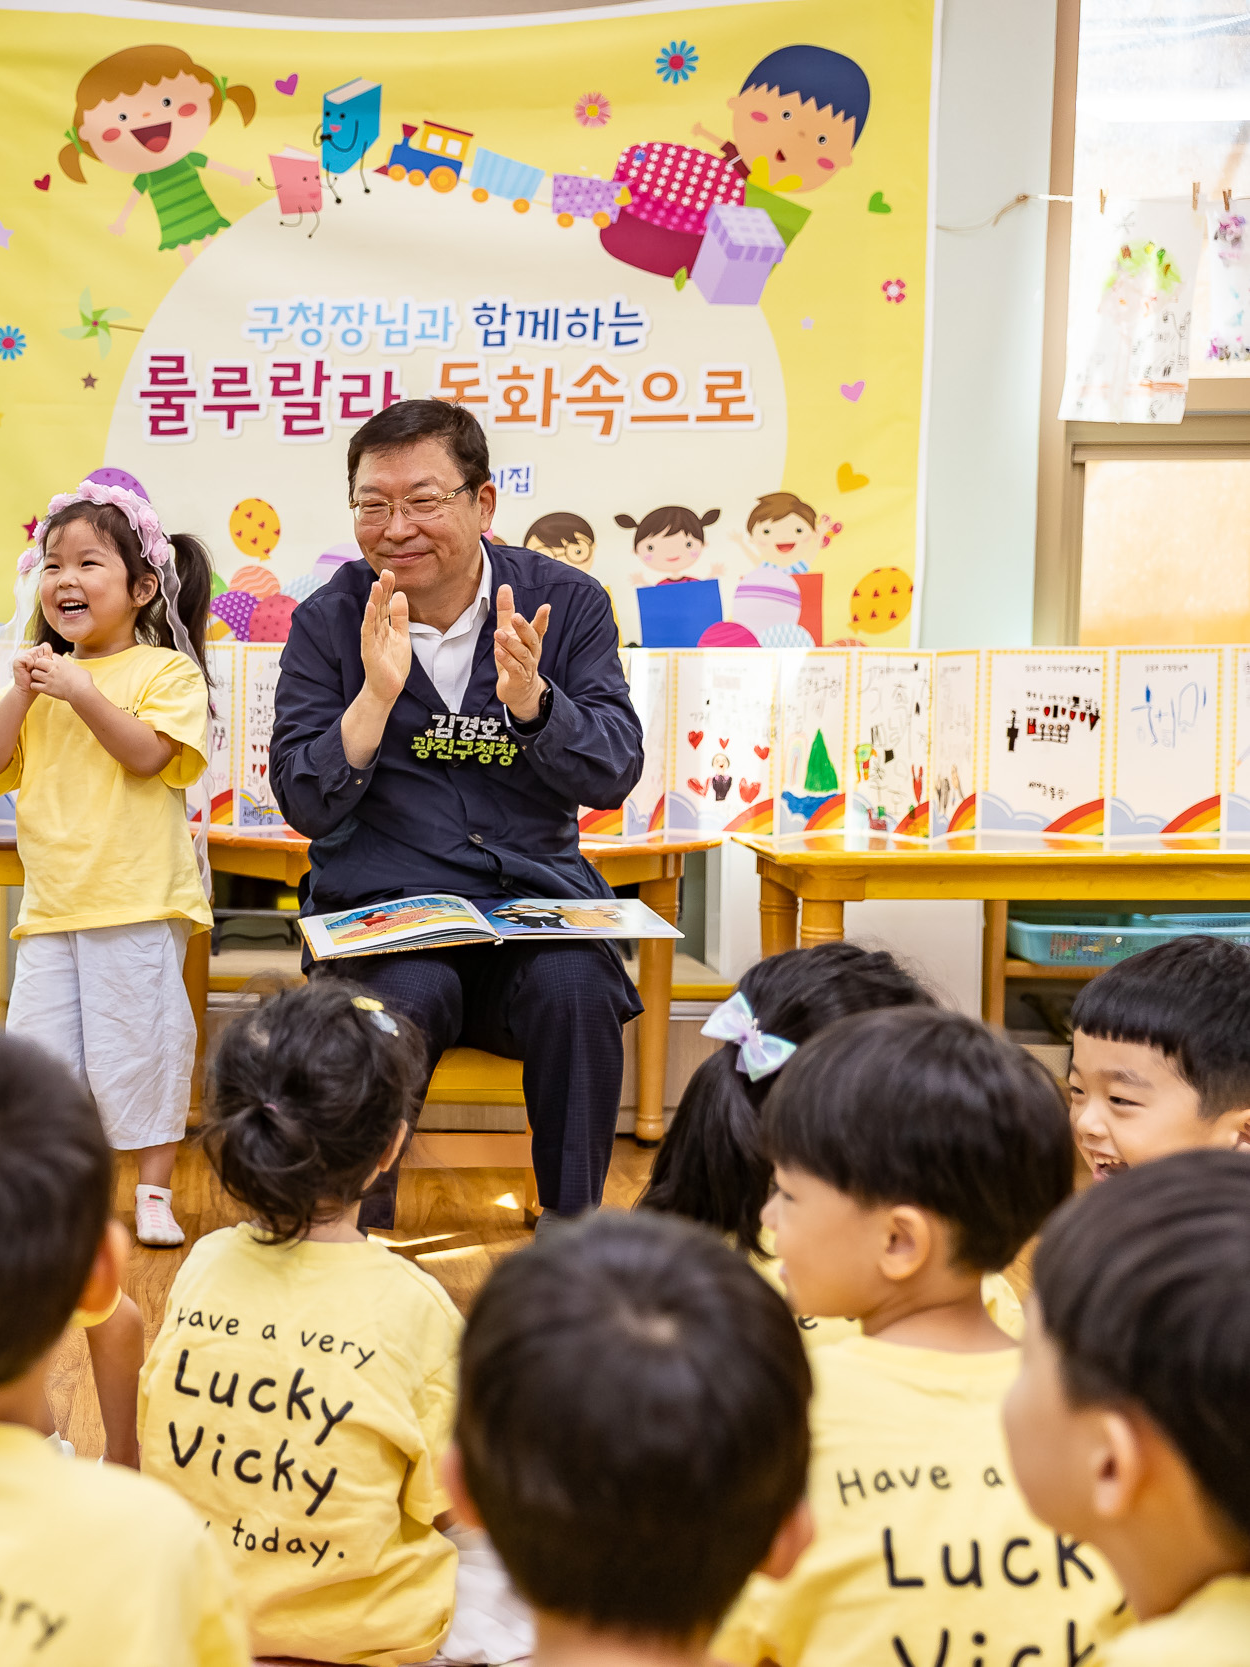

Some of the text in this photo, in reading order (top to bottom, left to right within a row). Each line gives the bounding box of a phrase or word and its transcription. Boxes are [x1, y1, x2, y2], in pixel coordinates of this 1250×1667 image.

[248, 301, 644, 348] 구청장님과 함께하는
[139, 355, 401, 436] 룰루랄라
[410, 736, 518, 766] 광진구청장
[431, 714, 501, 740] 김경호
[261, 1323, 277, 1340] a
[301, 1330, 376, 1370] very
[174, 1348, 354, 1447] Lucky
[168, 1420, 339, 1518] Vicky
[836, 1464, 1005, 1507] Have a
[231, 1517, 345, 1568] today.
[882, 1527, 1098, 1589] Luck
